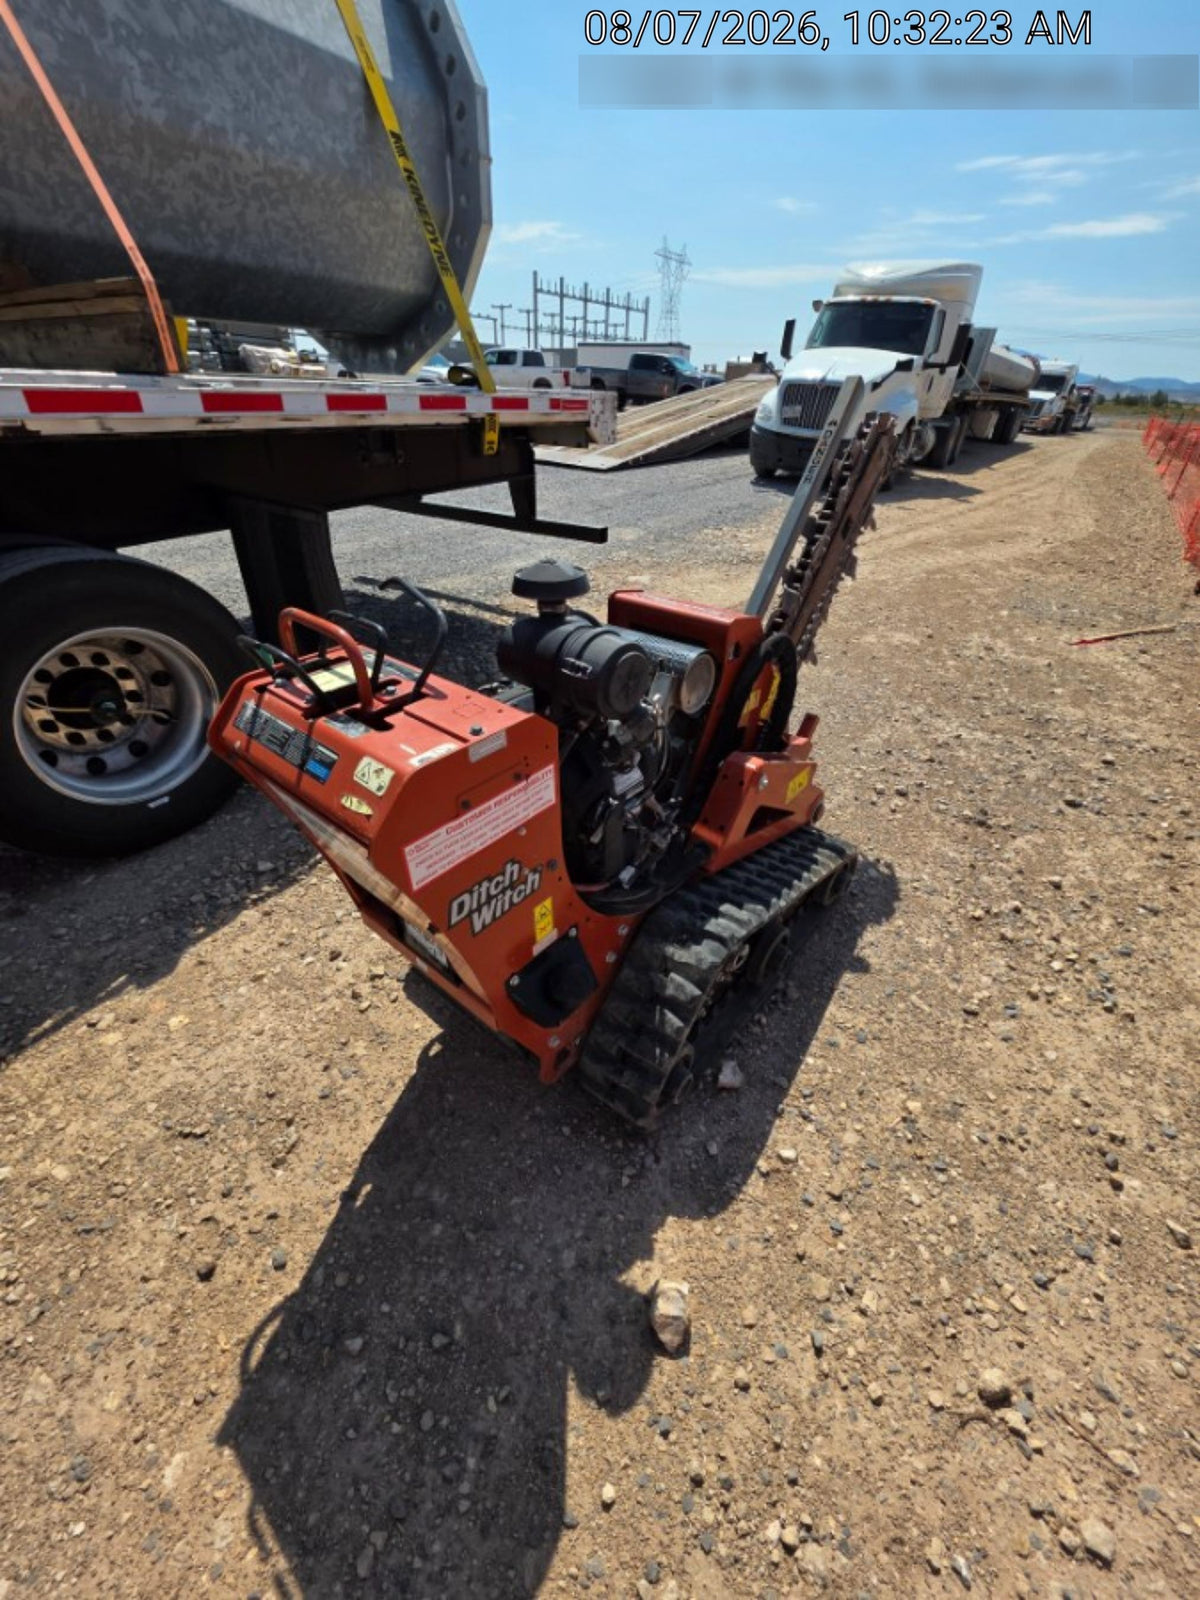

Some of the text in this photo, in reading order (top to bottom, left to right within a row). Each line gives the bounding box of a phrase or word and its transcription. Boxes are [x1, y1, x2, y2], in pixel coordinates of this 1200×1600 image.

[402, 166, 453, 279] KINEDYNE
[449, 858, 523, 929] Ditch
[470, 864, 544, 937] Witch
